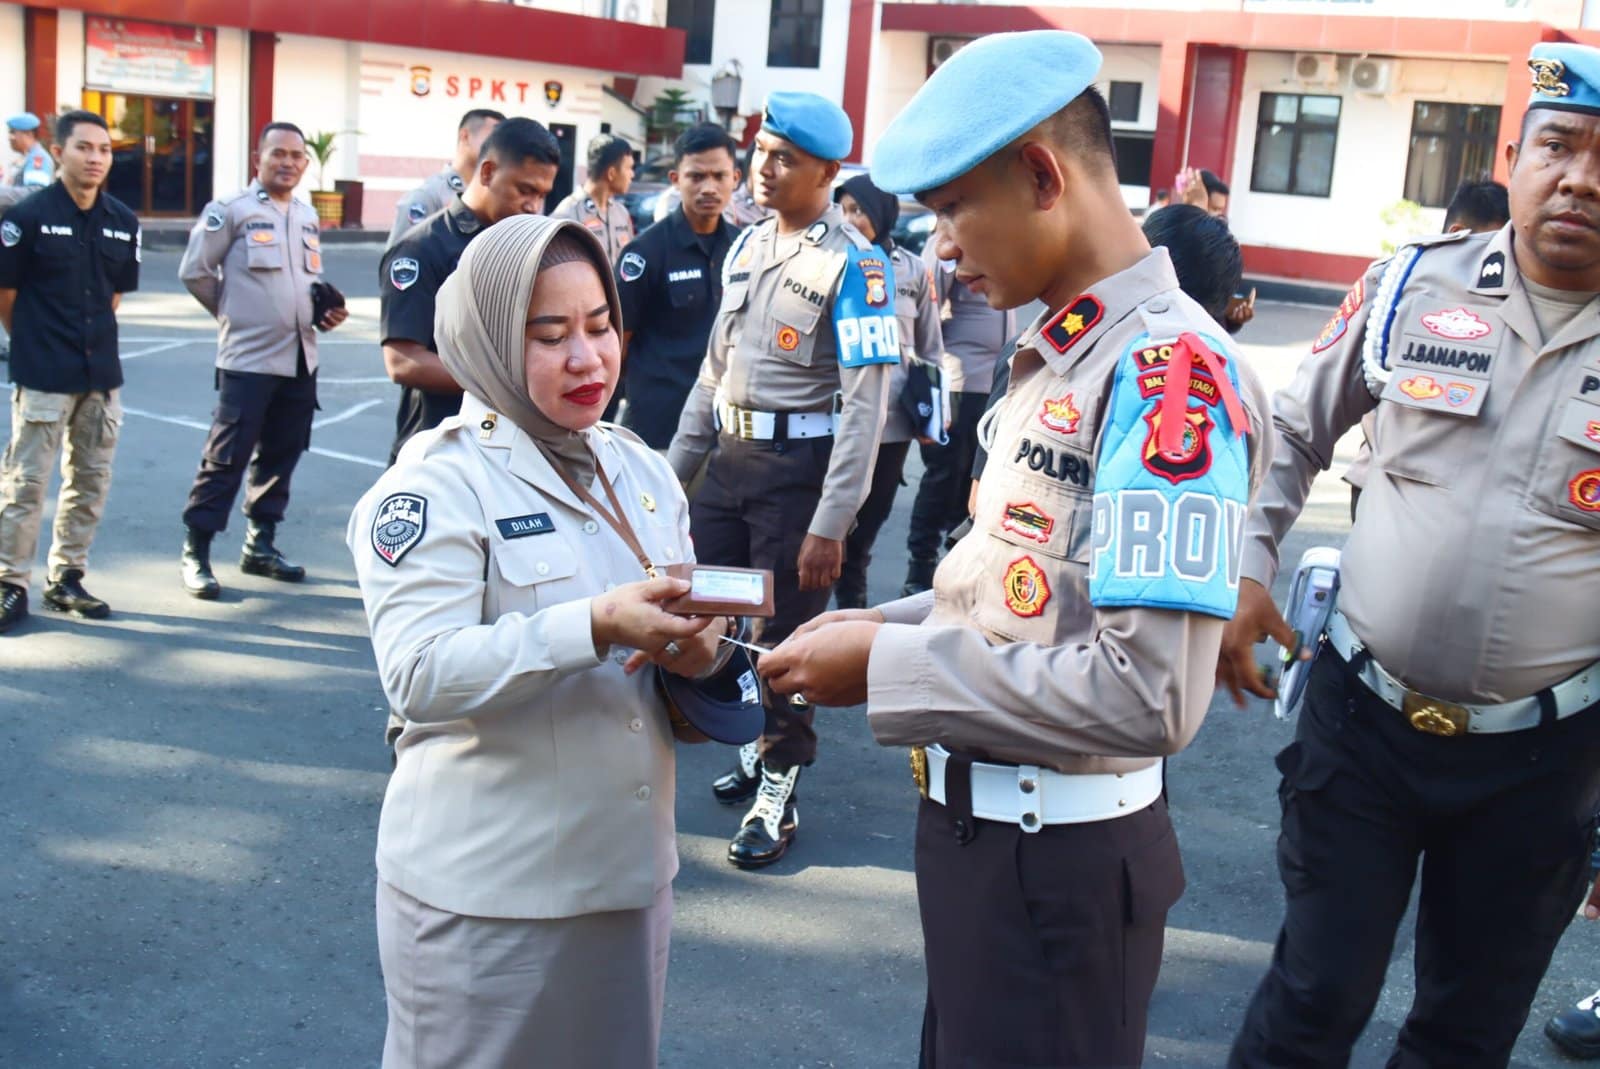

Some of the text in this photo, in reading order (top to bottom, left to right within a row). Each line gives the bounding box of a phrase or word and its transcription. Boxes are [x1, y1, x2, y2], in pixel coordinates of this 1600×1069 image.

[446, 76, 529, 102] SPKT
[784, 278, 825, 307] POLRI
[1402, 342, 1491, 373] J.BANAPON
[1015, 438, 1090, 486] POLRI
[511, 518, 543, 532] DILAH
